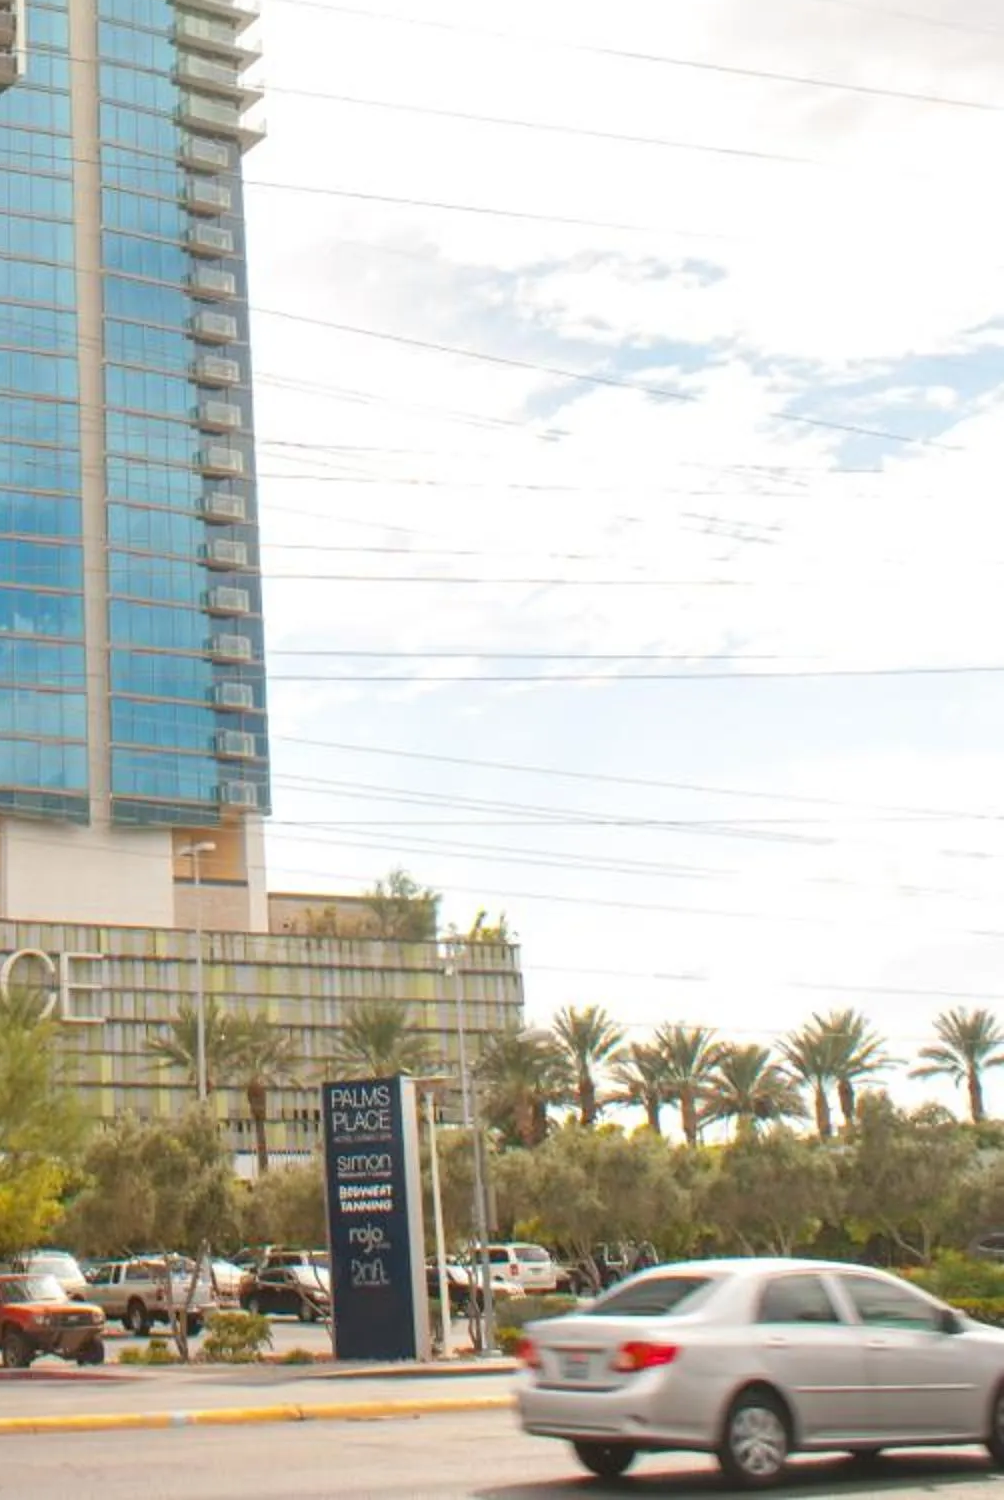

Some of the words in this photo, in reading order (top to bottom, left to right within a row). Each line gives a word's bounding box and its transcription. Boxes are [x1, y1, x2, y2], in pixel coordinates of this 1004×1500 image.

[331, 1086, 390, 1108] PALMS
[332, 1109, 391, 1132] PLACE
[337, 1154, 392, 1171] simon
[340, 1199, 393, 1213] TANNING
[349, 1223, 384, 1253] rojo
